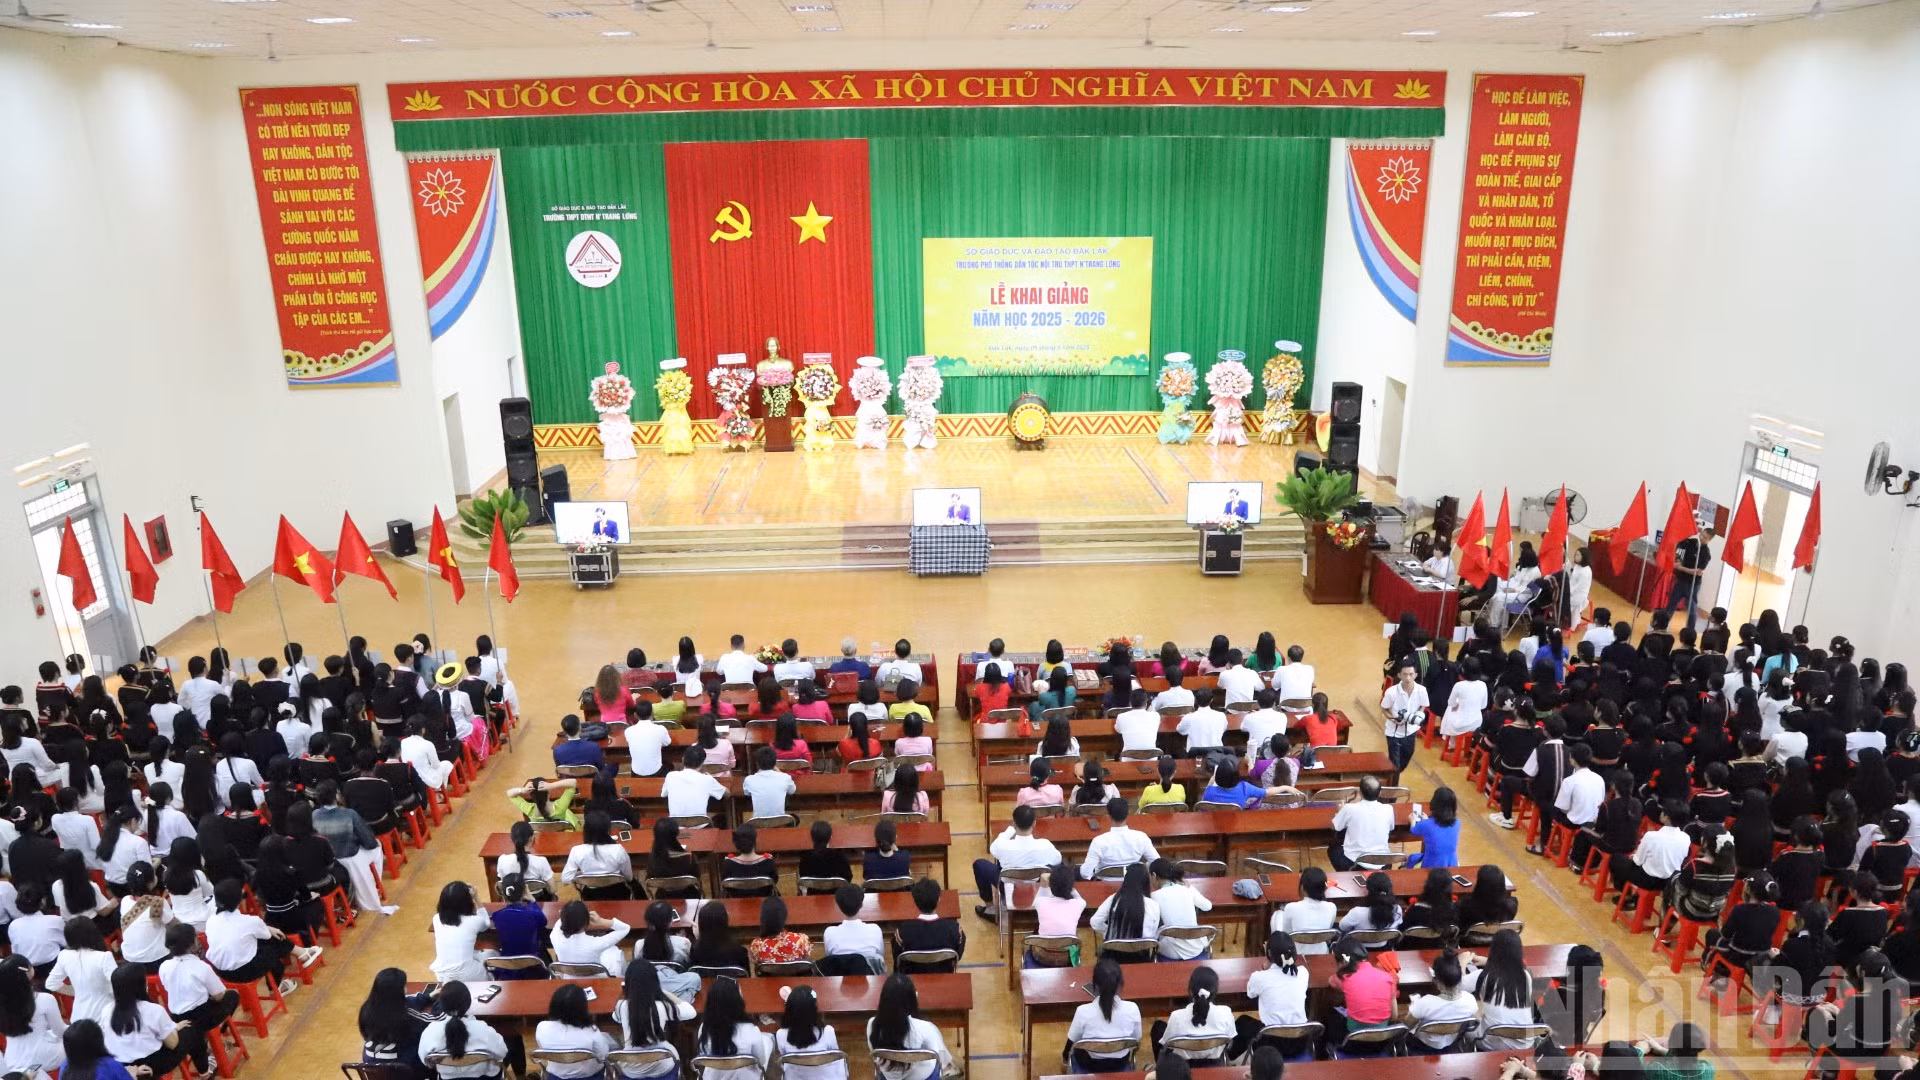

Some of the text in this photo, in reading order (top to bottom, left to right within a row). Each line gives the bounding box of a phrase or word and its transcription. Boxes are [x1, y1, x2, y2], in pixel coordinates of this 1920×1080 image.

[465, 71, 1376, 110] NƯỚC CỘNG HÒA XÃ HỘI CHỦ NGHĨA VIỆT NAM
[1513, 87, 1526, 104] ĐỂ
[1526, 90, 1546, 105] LÀM
[1549, 90, 1571, 107] VIỆC,
[284, 100, 309, 116] SÔNG
[310, 100, 329, 118] VIỆT
[332, 101, 352, 114] NAM
[1499, 110, 1551, 127] LÀM NGƯỜI,
[258, 121, 351, 139] CÓ TRỞ NÊN TƯƠI ĐẸP
[1494, 131, 1551, 149] LÀM CÁN BỘ.
[262, 143, 353, 160] HAY KHÔNG, DÂN TỘC
[1480, 150, 1561, 169] HỌC ĐỂ PHỤNG SỰ
[263, 164, 360, 184] VIỆT NAM CÓ BƯỚC TỚI
[1476, 171, 1562, 188] ĐOÀN THỂ, GIAI CẤP
[273, 183, 355, 203] ĐÀI VINH QUANG ĐỂ
[1479, 191, 1555, 208] VÀ NHÂN DÂN, TỔ
[280, 207, 355, 224] SÁNH VAI VỚI CÁC
[1469, 212, 1557, 230] QUỐC VÀ NHÂN LOẠI.
[282, 227, 359, 244] CƯỜNG QUỐC NĂM
[1465, 232, 1557, 250] MUỐN ĐẠT MỤC ĐÍCH,
[274, 249, 374, 267] CHÂU ĐƯỢC HAY KHÔNG,
[1466, 252, 1552, 270] THÌ PHẢI CẦN, KIỆM,
[288, 269, 366, 286] CHÍNH LÀ NHỜ MỘT
[1479, 273, 1534, 288] LIÊM, CHÍNH,
[283, 289, 377, 306] PHẦN LỚN Ở CÔNG HỌC
[990, 281, 1088, 305] LỄ KHAI GIẢNG
[1467, 293, 1481, 306] CHÍ
[1483, 292, 1510, 308] CÔNG,
[1512, 292, 1524, 306] VÔ
[293, 312, 309, 329] TẬP
[311, 310, 329, 326] CỦA
[330, 311, 347, 325] CÁC
[973, 310, 1000, 327] NĂM
[1005, 312, 1027, 330] HỌC
[1031, 312, 1062, 326] 2025
[1075, 312, 1106, 326] 2026
